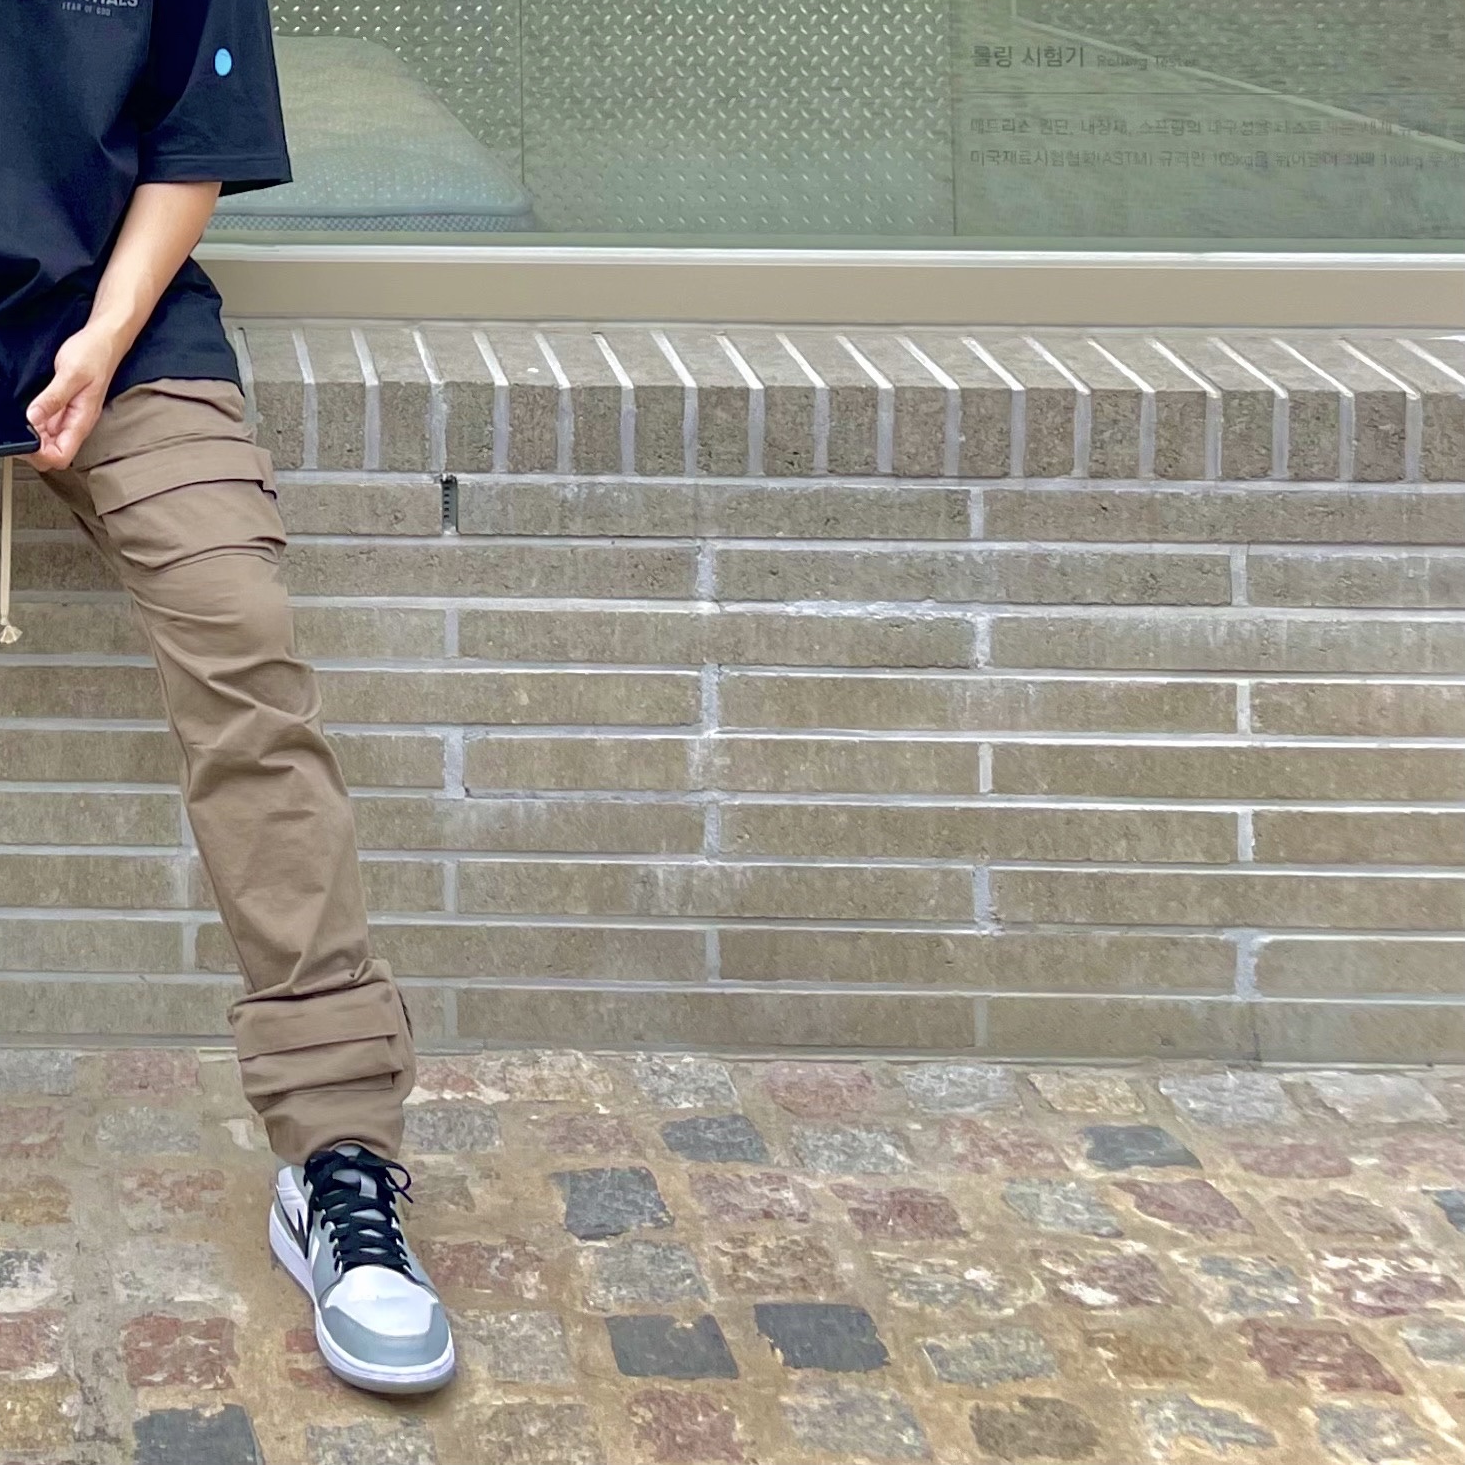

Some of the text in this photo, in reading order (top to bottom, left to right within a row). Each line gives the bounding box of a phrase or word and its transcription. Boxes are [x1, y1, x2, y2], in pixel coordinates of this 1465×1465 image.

[61, 1, 81, 11] FEAR
[84, 5, 92, 13] OF
[1021, 45, 1085, 68] 시험기
